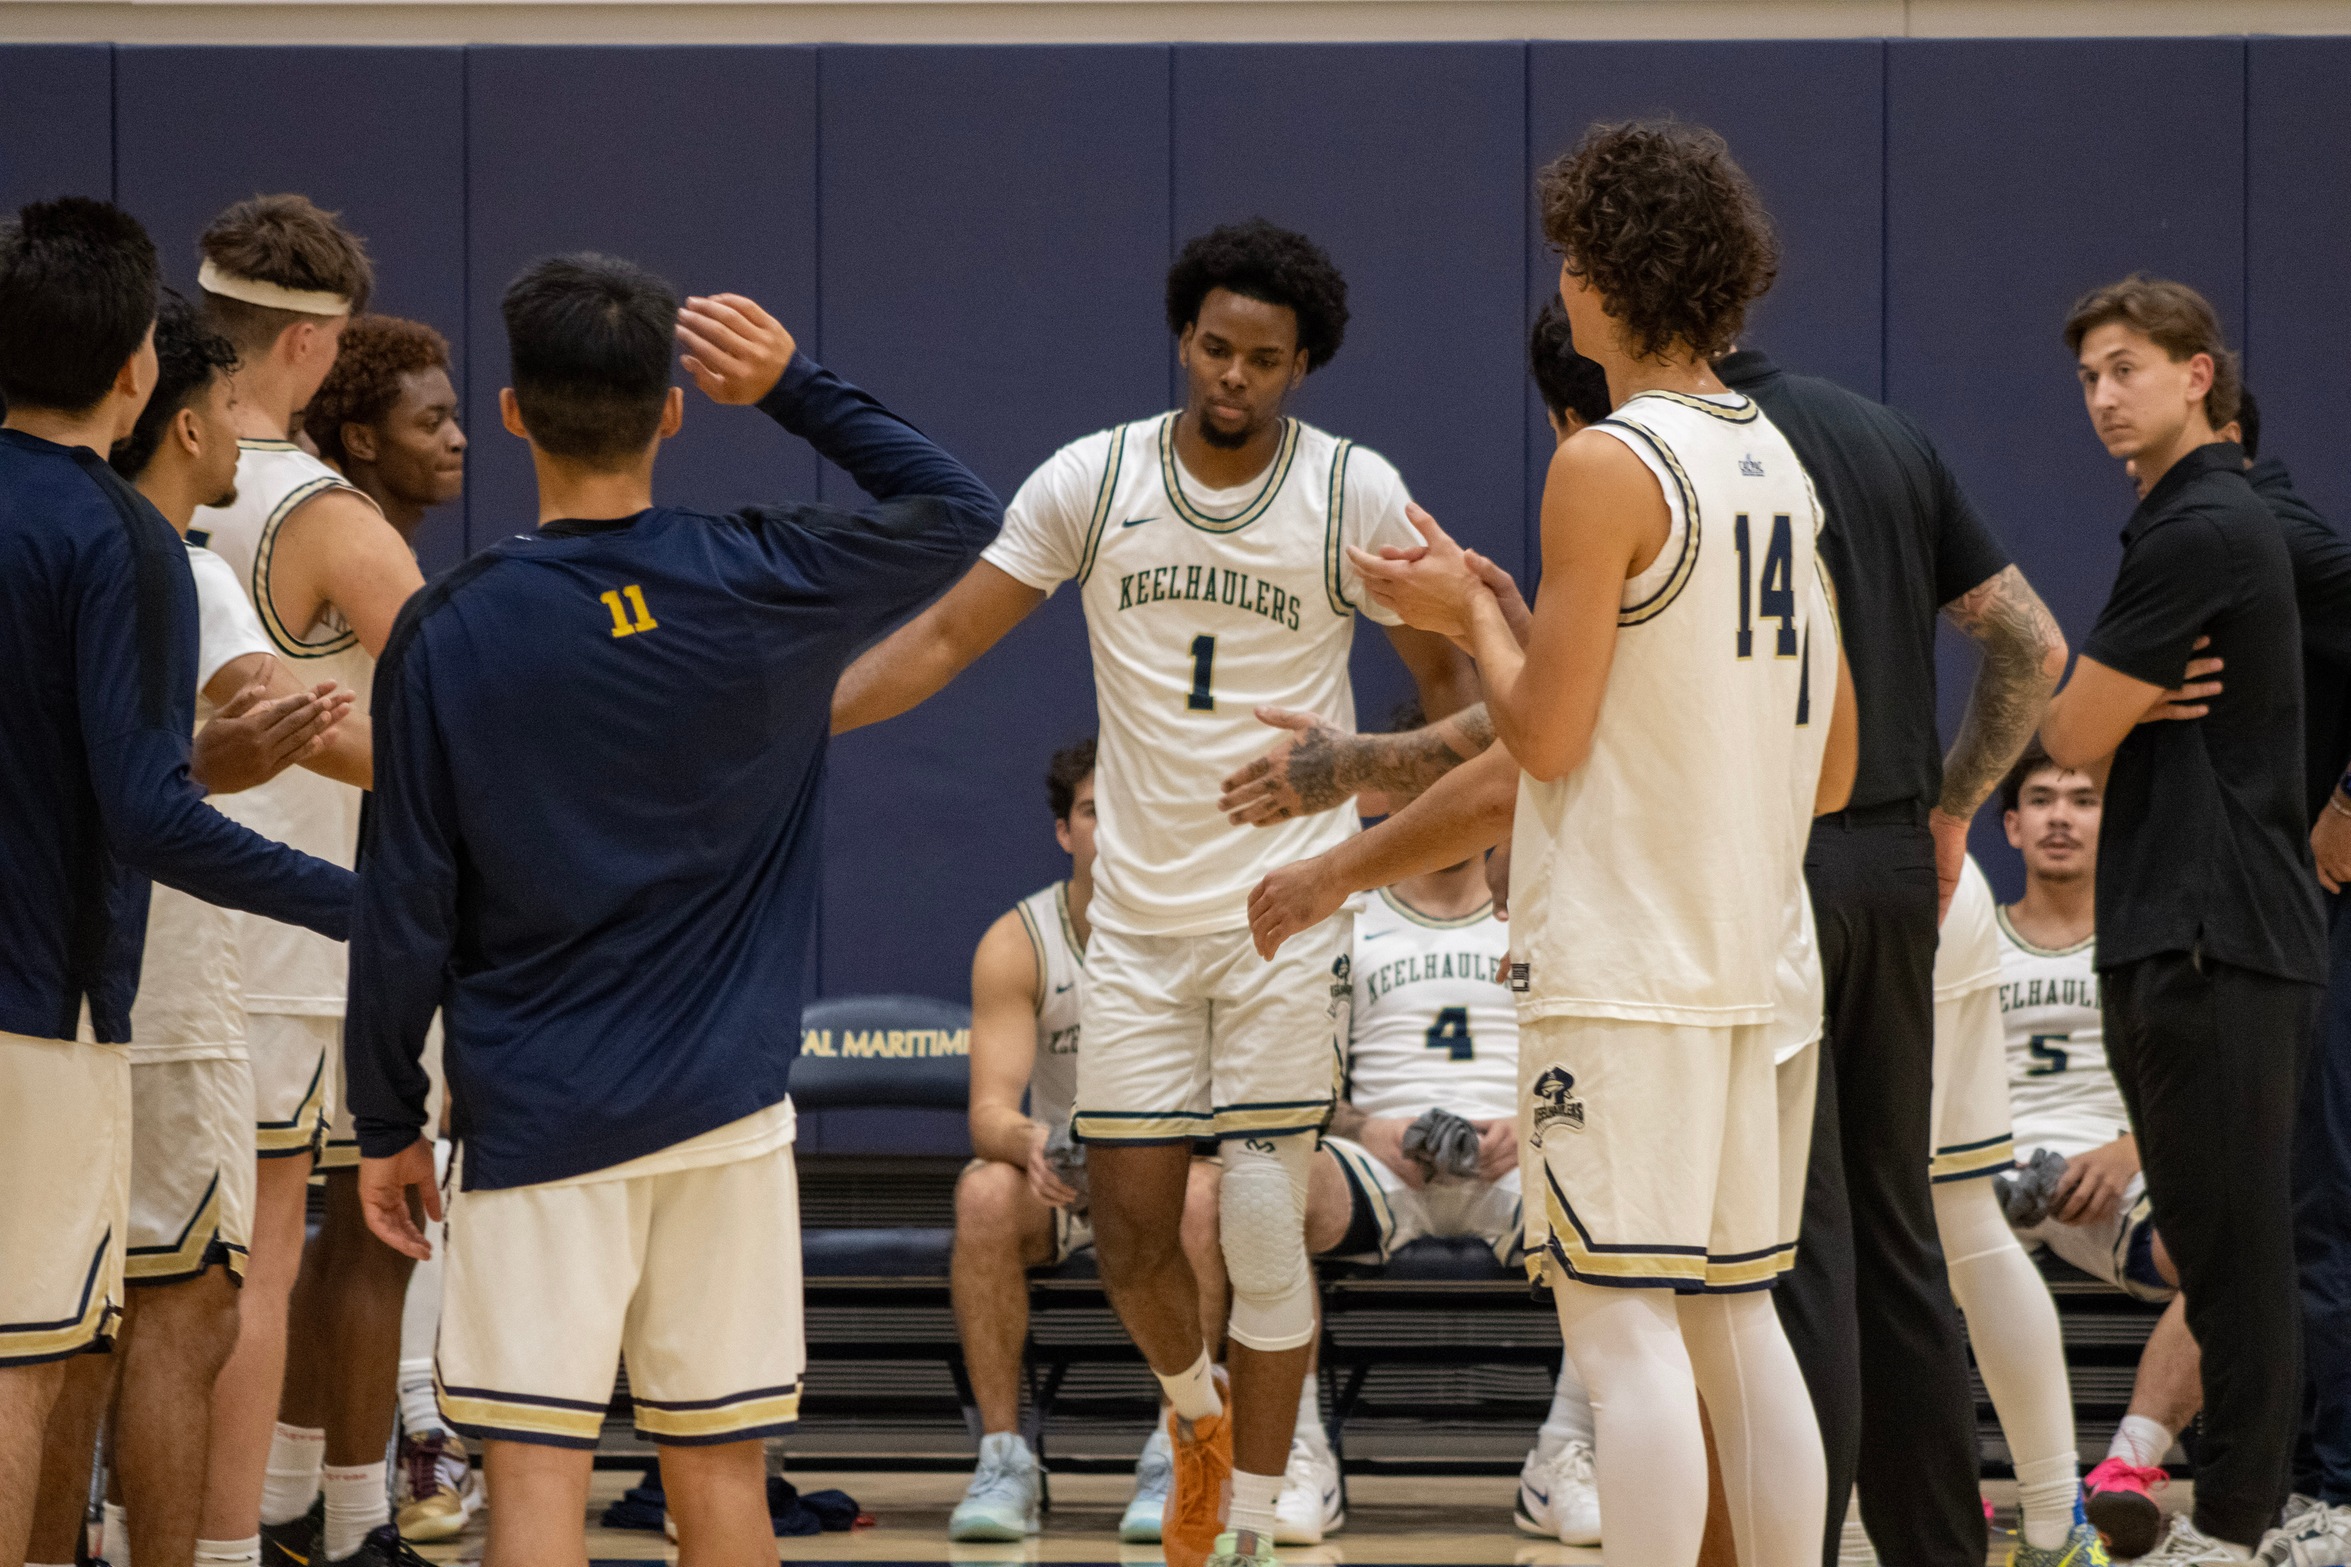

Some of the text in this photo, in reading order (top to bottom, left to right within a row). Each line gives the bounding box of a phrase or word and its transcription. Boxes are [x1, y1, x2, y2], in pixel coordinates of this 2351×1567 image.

[600, 584, 658, 638] 11
[1118, 565, 1301, 632] KEELHAULERS
[1734, 511, 1797, 661] 14
[1184, 632, 1218, 713] 1
[1366, 952, 1512, 1006] KEELHAULE
[1999, 979, 2101, 1014] ELHAUL
[801, 1029, 838, 1058] AL
[1424, 1006, 1474, 1062] 4
[2026, 1034, 2070, 1077] 5
